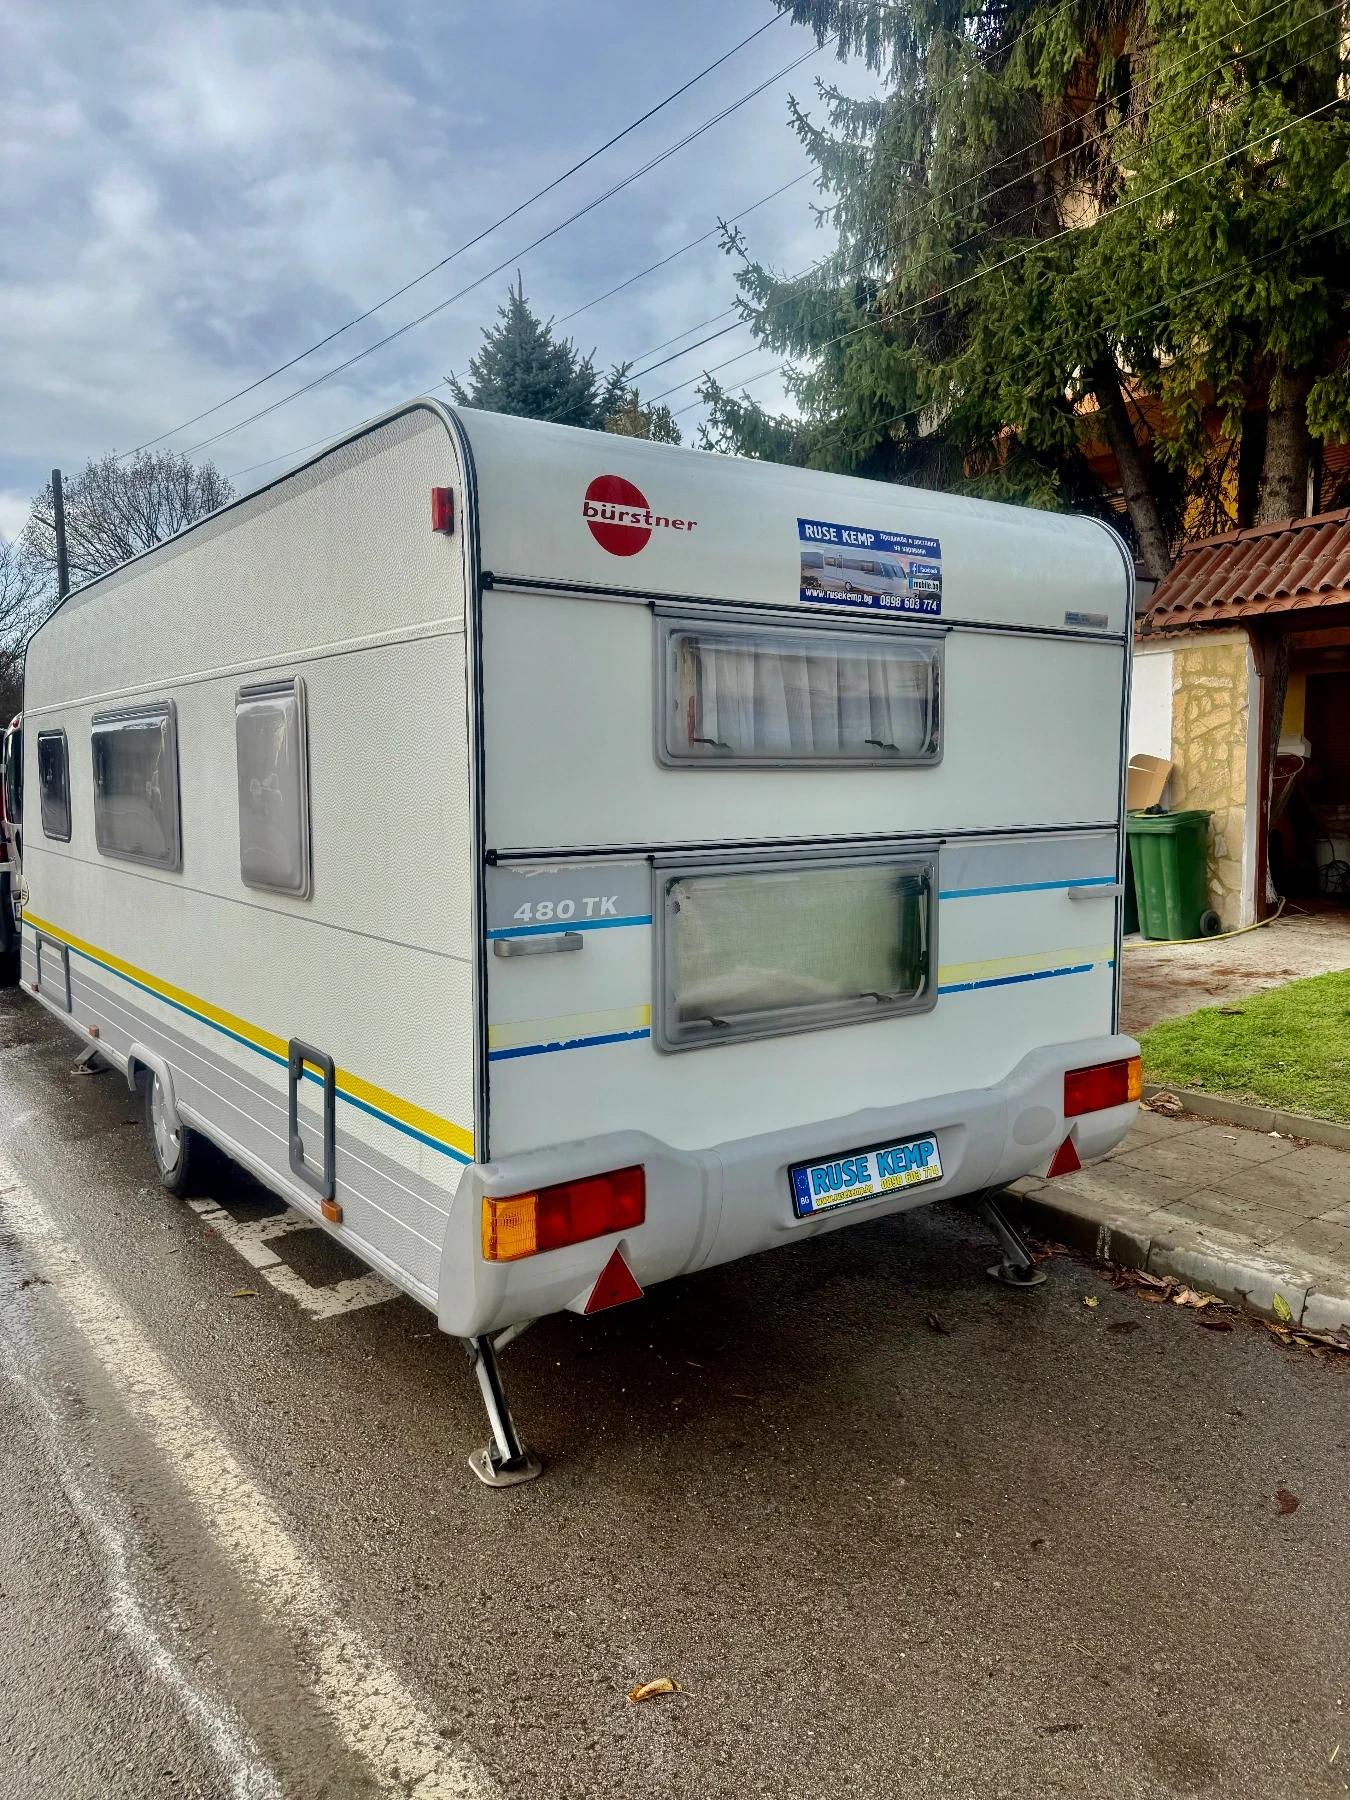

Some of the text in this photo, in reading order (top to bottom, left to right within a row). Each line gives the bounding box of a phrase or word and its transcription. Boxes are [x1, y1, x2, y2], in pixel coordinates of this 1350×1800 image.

[583, 501, 698, 531] bürstner
[805, 524, 875, 546] RUSE KEMP
[914, 580, 939, 591] mobile.bg
[805, 588, 938, 610] www.rusekemp.bg 0898 603 774
[514, 896, 619, 922] 480 TK
[811, 1141, 935, 1195] RUSE KEMP
[816, 1165, 940, 1207] www.rusekemp.bg 0898 603 774
[800, 1196, 810, 1205] BG
